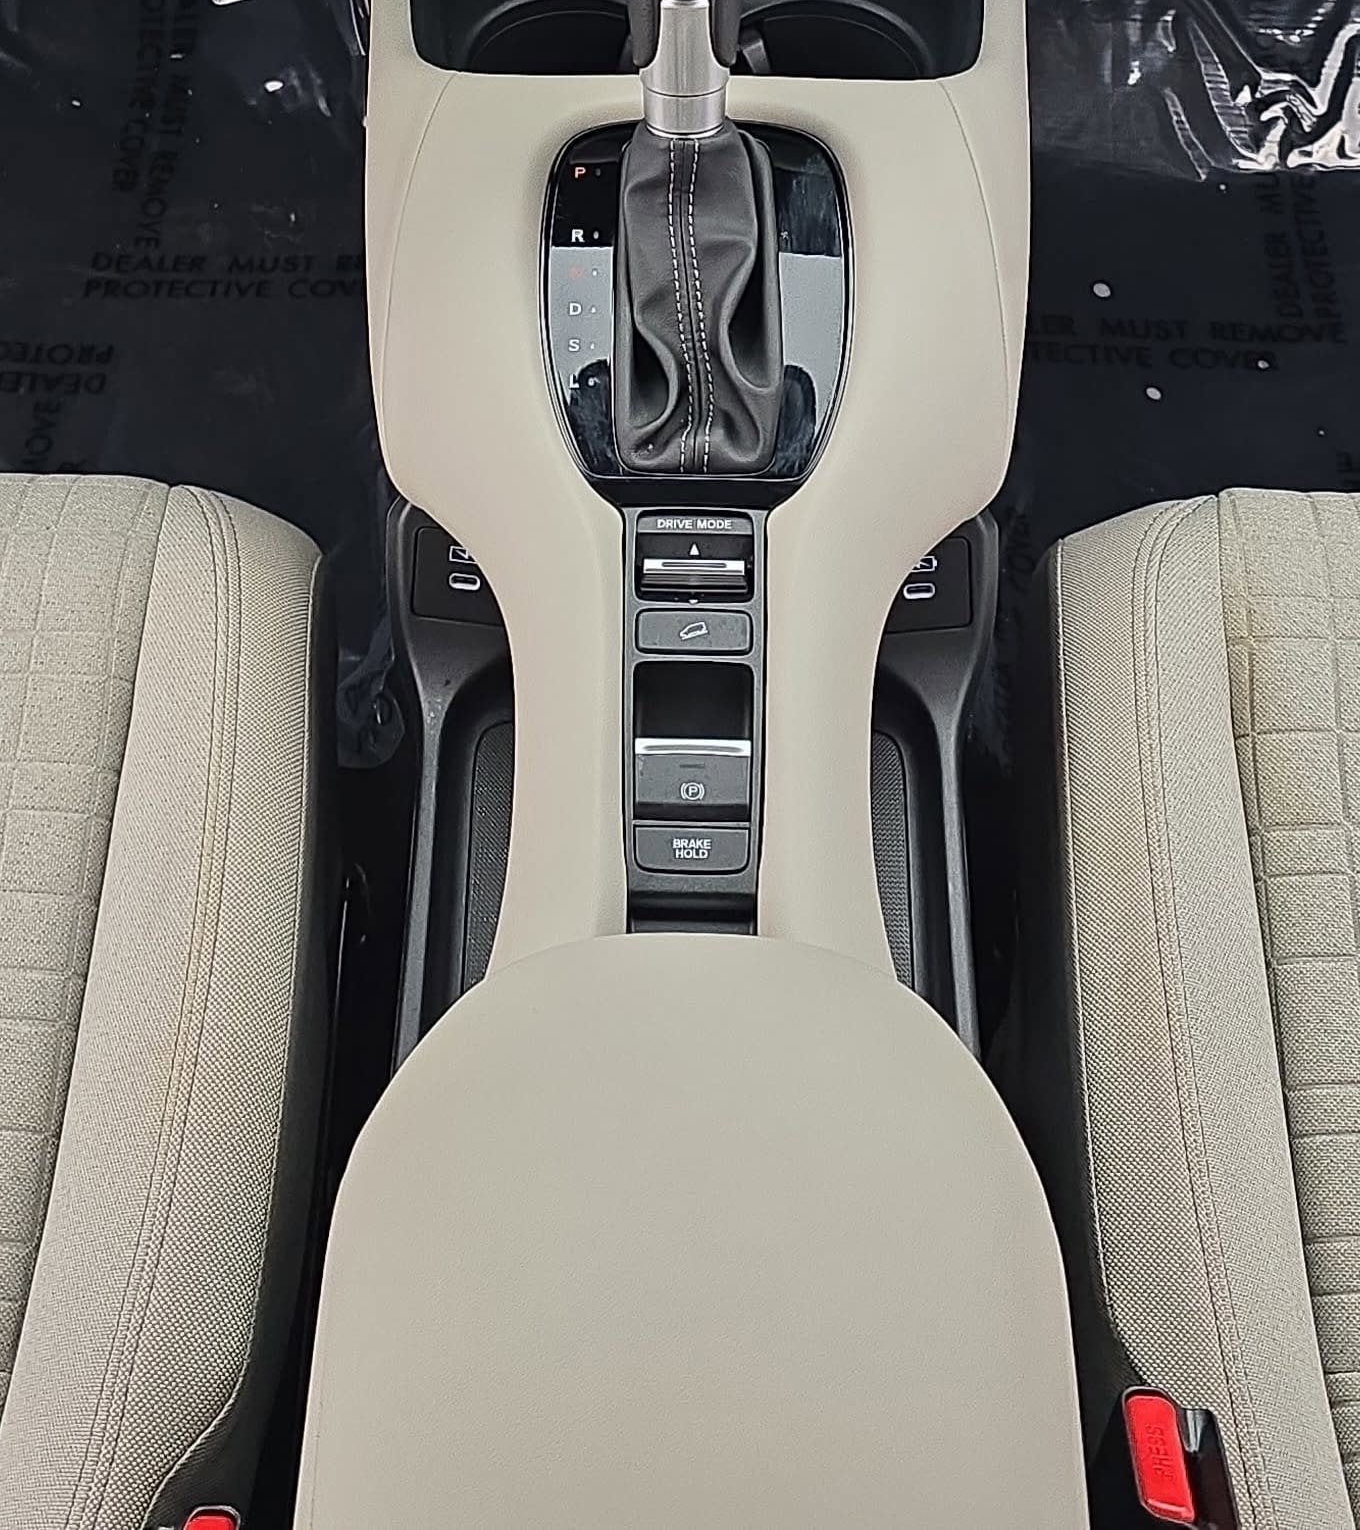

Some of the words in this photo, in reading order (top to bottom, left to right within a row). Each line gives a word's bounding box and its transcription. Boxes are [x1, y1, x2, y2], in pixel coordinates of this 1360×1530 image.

[574, 166, 586, 179] P
[571, 229, 585, 243] R
[89, 251, 208, 274] DEALER
[227, 253, 318, 275] MUST
[80, 276, 276, 300] PROTECTIVE
[569, 302, 582, 316] D
[1099, 318, 1190, 342] MUST
[1207, 321, 1349, 346] REMOVE
[568, 339, 581, 352] S
[1168, 346, 1280, 372] COVER
[657, 518, 693, 529] DRIVE
[696, 518, 732, 529] MODE
[672, 838, 712, 849] BRAKE
[675, 848, 709, 859] HOLD
